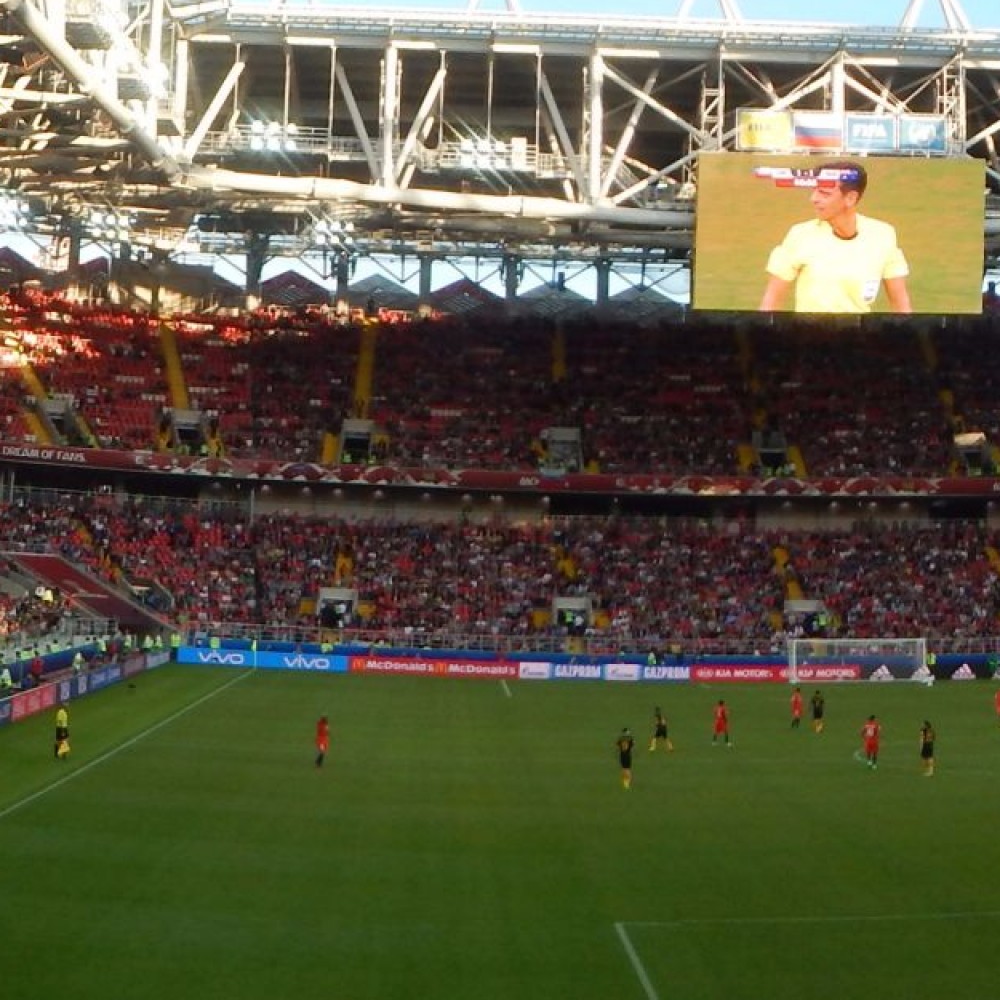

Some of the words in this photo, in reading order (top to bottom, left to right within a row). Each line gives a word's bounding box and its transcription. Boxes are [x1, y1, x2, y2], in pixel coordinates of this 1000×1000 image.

[2, 446, 39, 458] DREAM
[41, 450, 55, 459] OF
[366, 660, 434, 672] McDonald's
[448, 663, 516, 675] McDonald's
[554, 664, 600, 678] GAZPROM
[644, 666, 690, 679] GAZPROM
[715, 668, 731, 678] KIA
[734, 668, 773, 678] MOTORS
